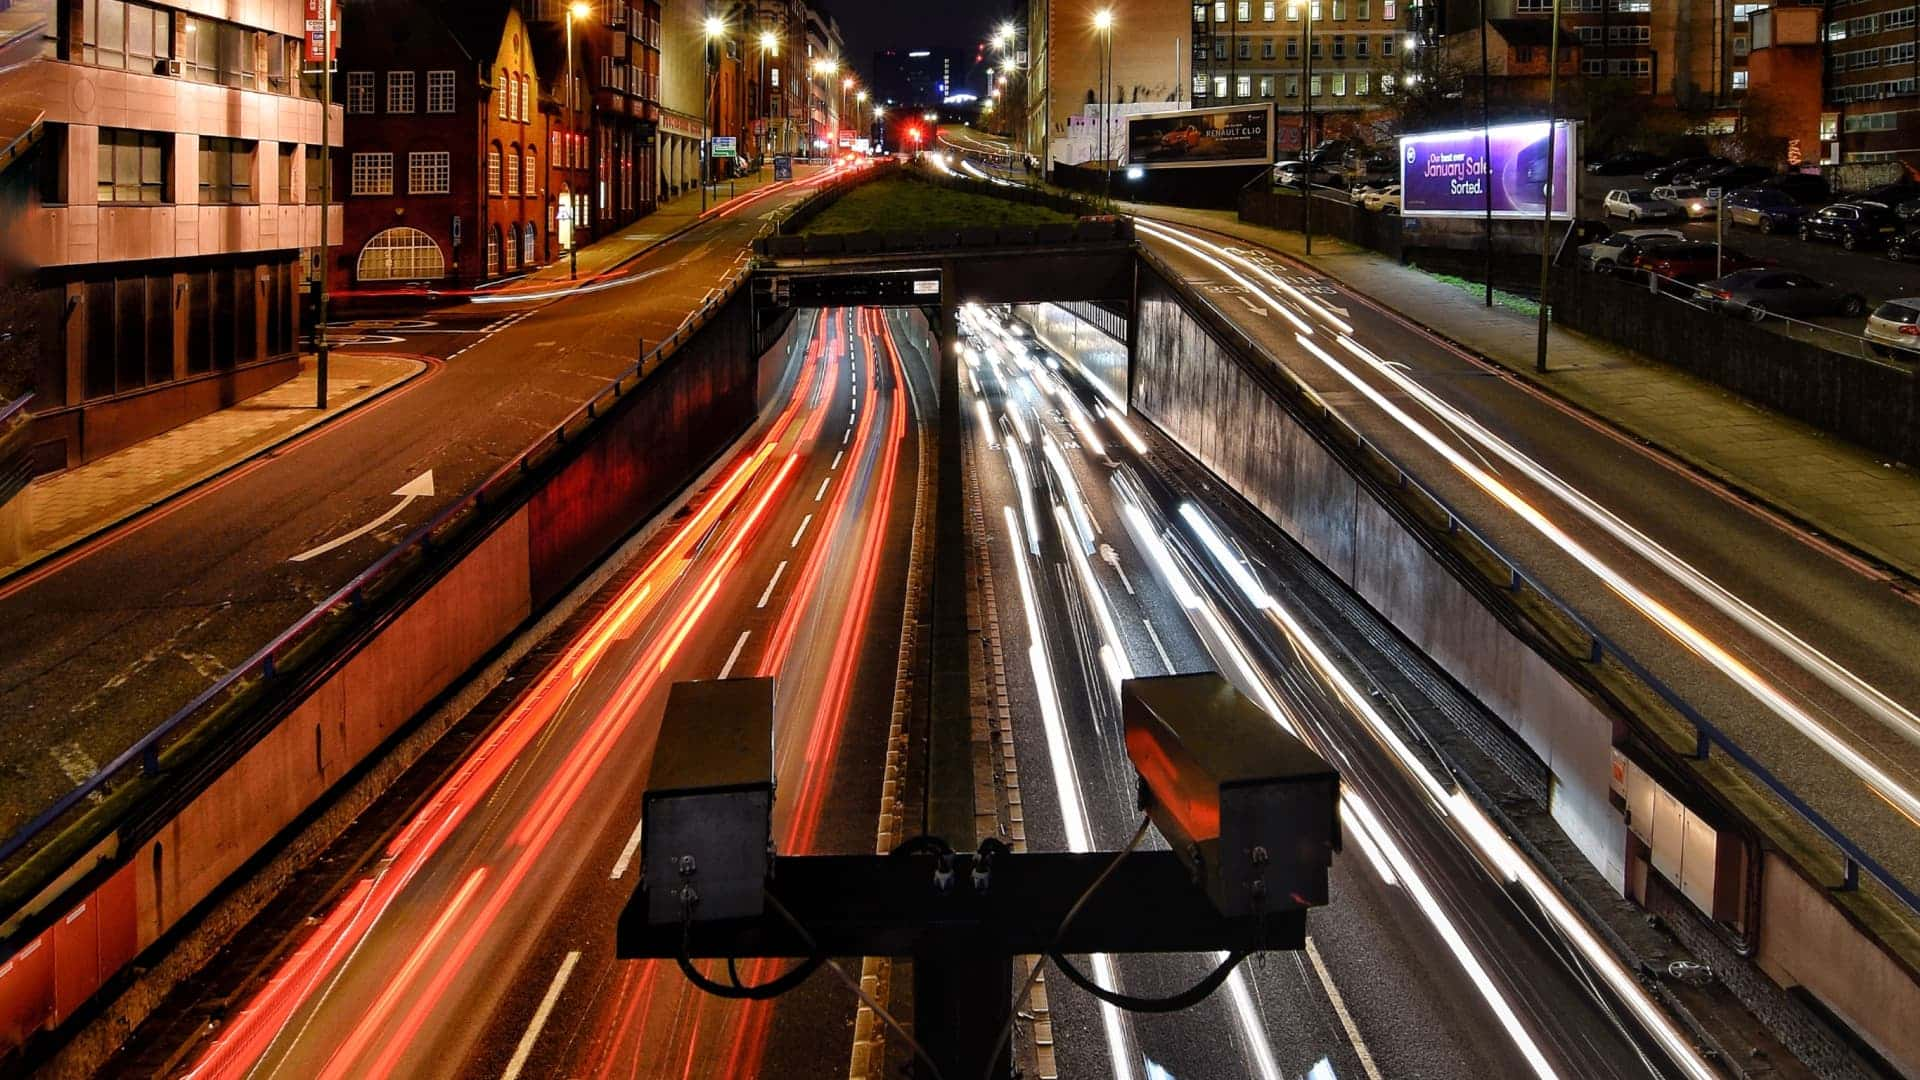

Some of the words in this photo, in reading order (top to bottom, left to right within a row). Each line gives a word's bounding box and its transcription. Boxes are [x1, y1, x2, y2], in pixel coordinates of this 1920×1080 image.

[1242, 127, 1261, 136] CLIO
[1424, 160, 1464, 180] January
[1451, 178, 1483, 194] Sorted.
